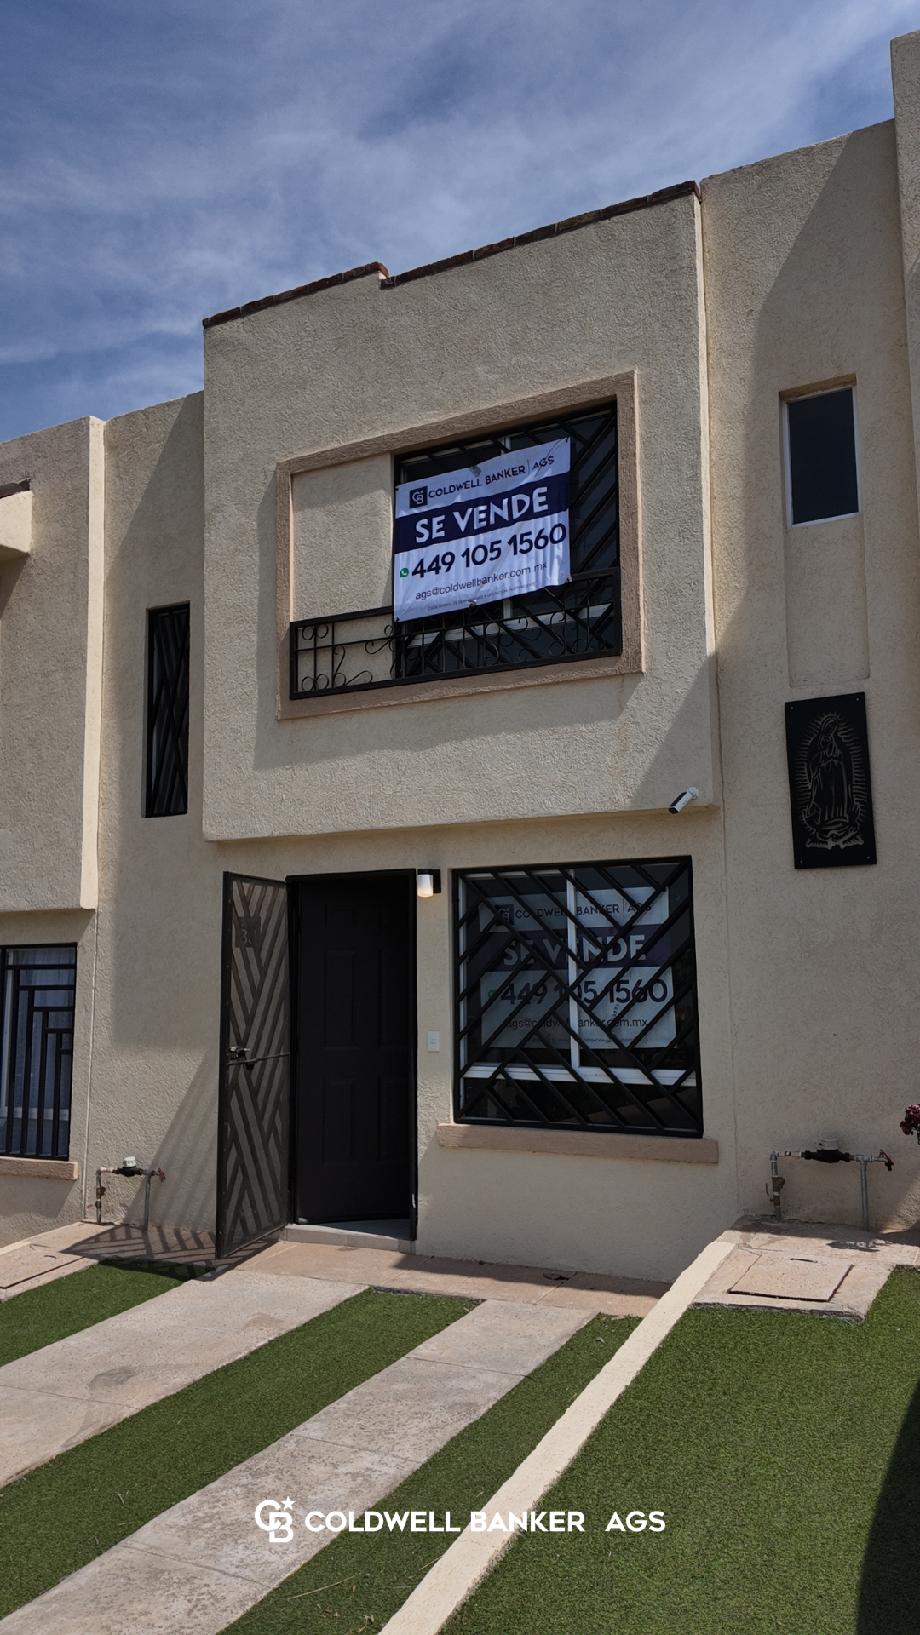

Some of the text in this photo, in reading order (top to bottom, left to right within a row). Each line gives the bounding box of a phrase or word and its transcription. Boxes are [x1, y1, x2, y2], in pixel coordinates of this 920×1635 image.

[428, 479, 481, 499] COLDWELL
[485, 465, 526, 485] BANKER
[531, 455, 555, 471] AGS
[415, 486, 549, 544] SE VENDE
[411, 523, 567, 578] 449 105 1560
[415, 562, 547, 601] ags@coldwellbanker.commx
[515, 907, 568, 919] CODWE
[542, 934, 648, 964] VNDE
[501, 982, 548, 1004] 449
[607, 978, 668, 1003] 1560
